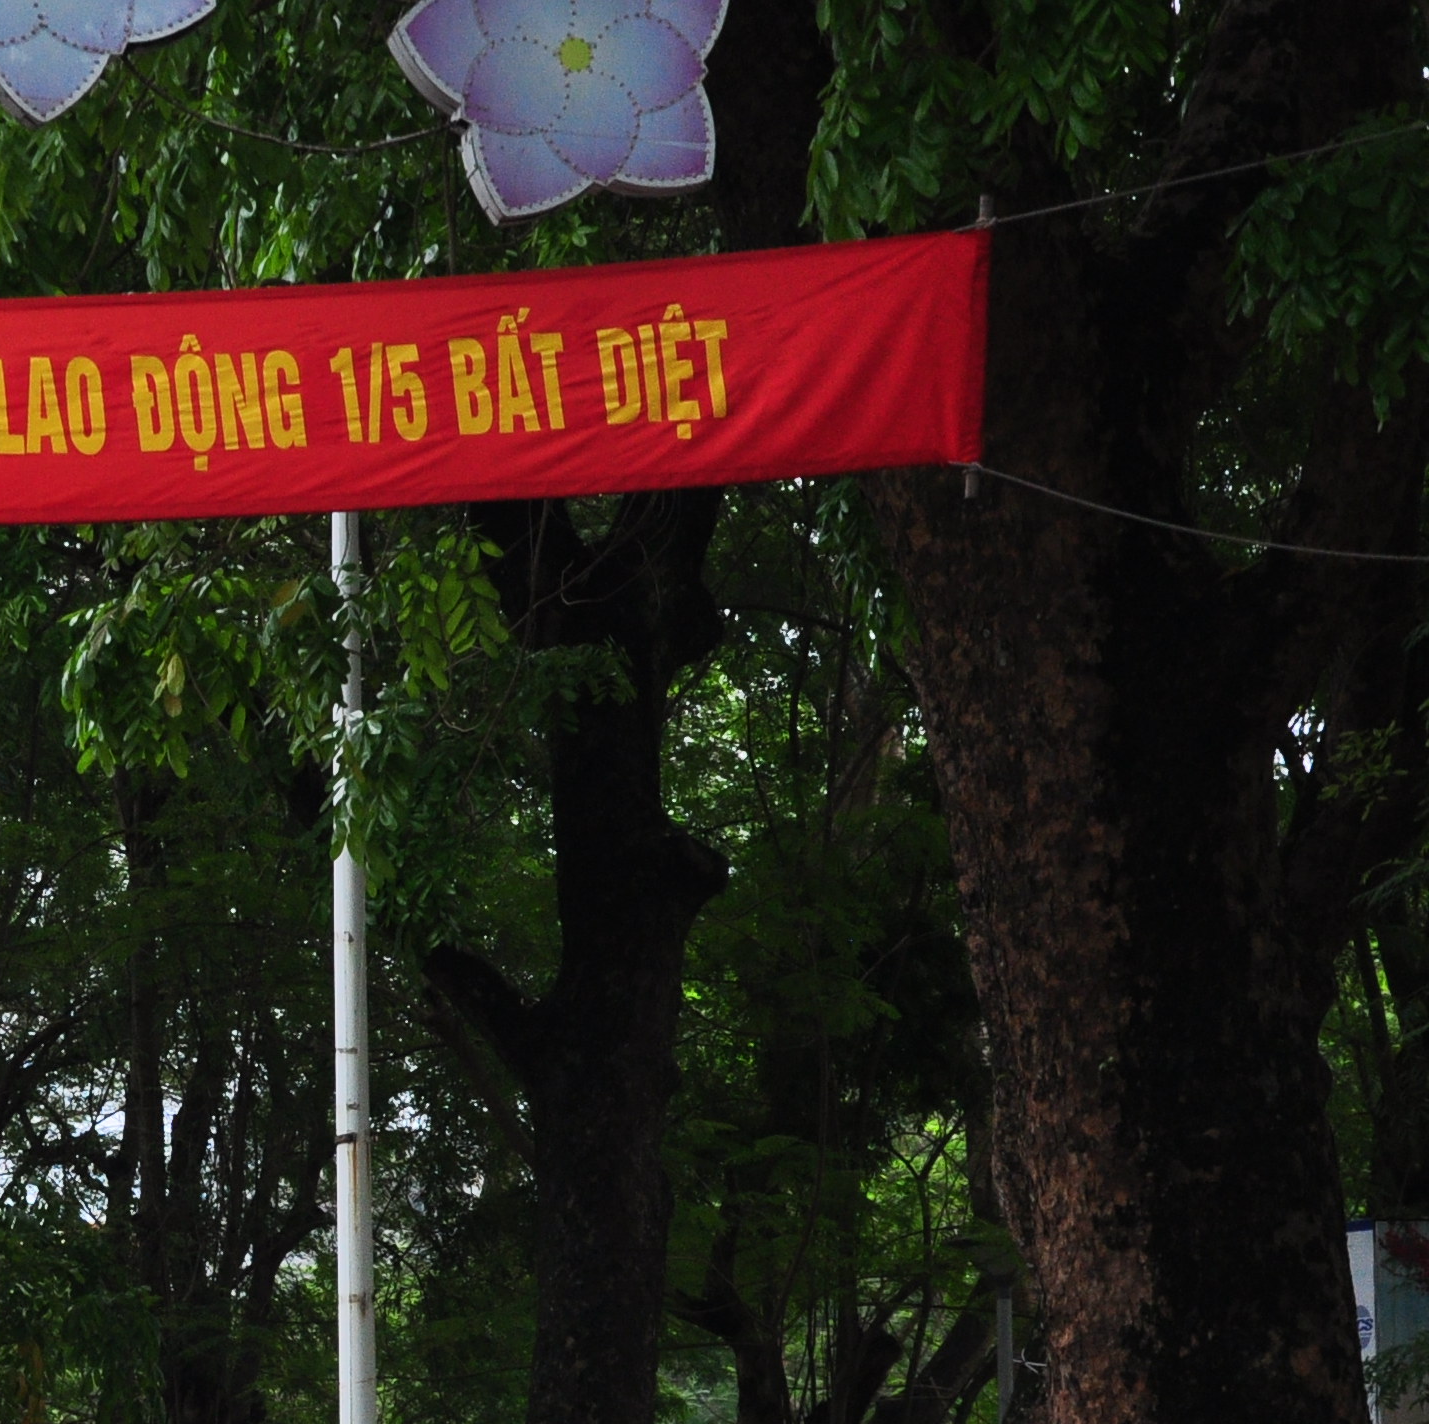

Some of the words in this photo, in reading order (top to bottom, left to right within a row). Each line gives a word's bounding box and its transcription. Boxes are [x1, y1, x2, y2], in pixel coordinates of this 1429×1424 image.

[130, 334, 308, 472] ĐỘNG
[329, 342, 429, 443] 1/5
[448, 307, 566, 436] BẤT
[596, 303, 729, 440] DIỆT
